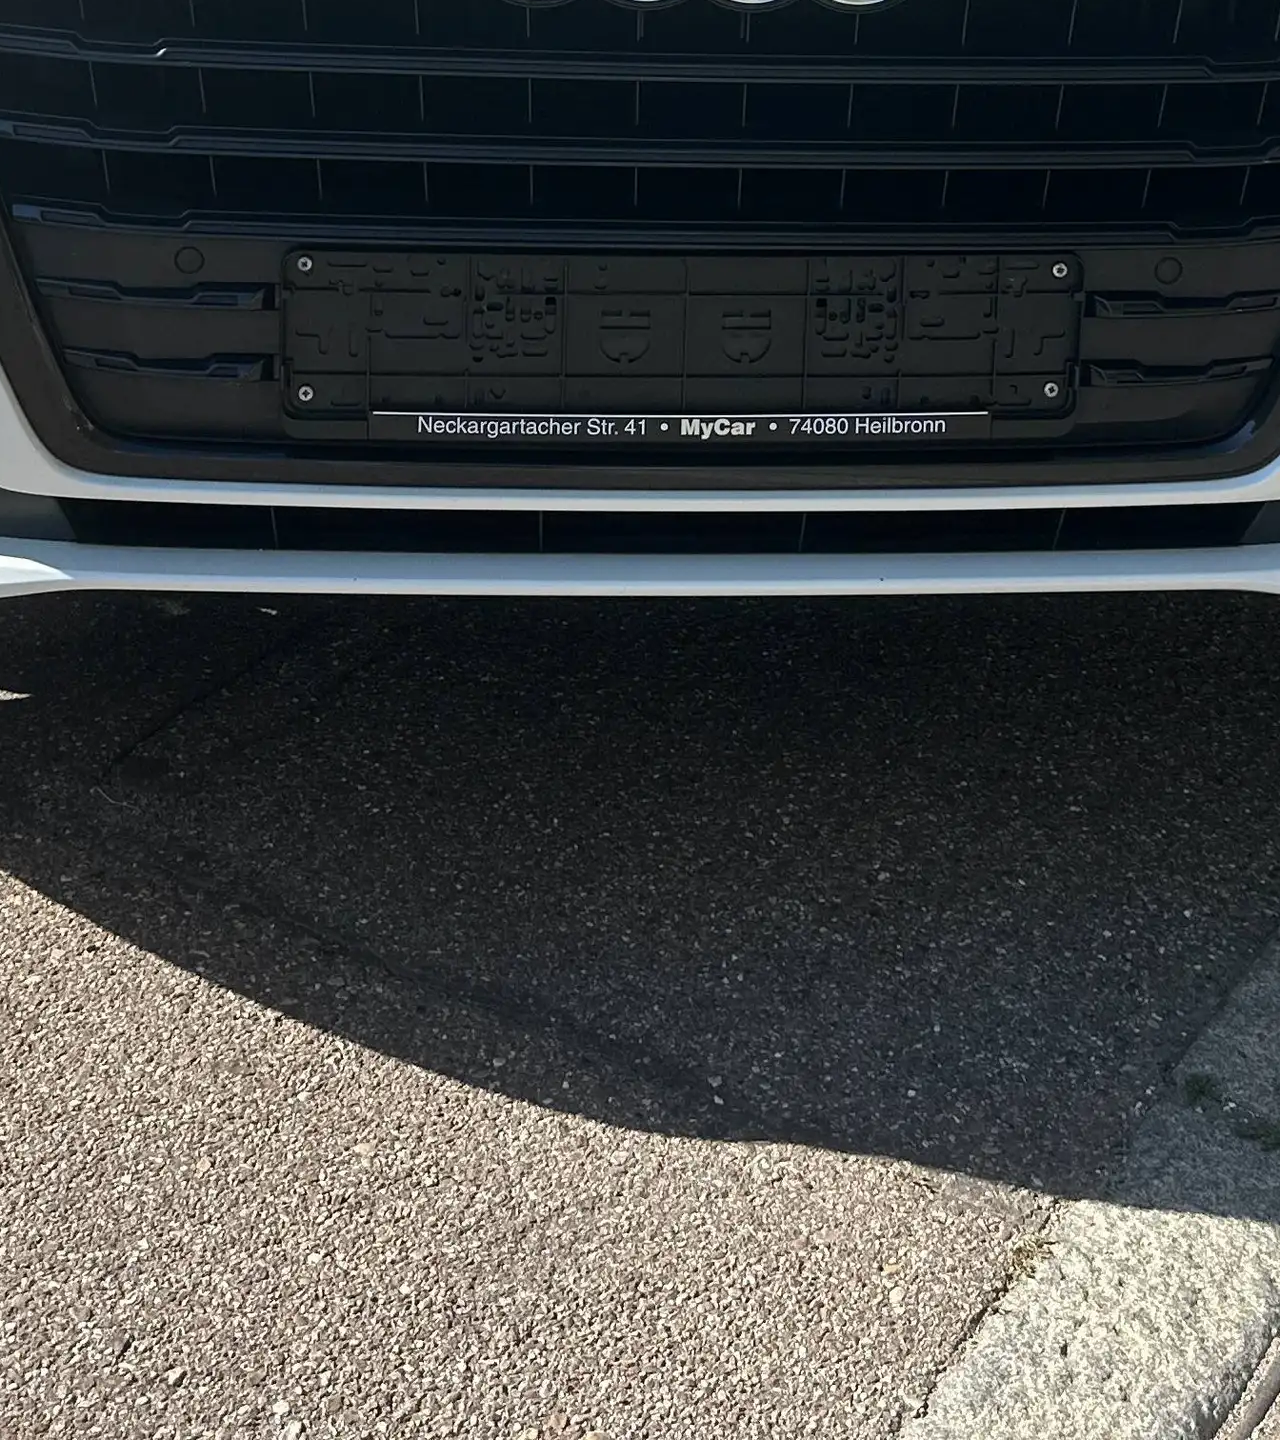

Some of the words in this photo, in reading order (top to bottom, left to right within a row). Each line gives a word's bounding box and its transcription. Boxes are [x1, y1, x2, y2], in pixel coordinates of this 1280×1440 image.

[417, 416, 581, 438] Neckargartacher
[586, 418, 618, 435] Str.
[624, 419, 646, 435] 41
[680, 418, 756, 439] MyCar
[788, 418, 849, 435] 74080
[855, 417, 946, 434] Heilbronn
